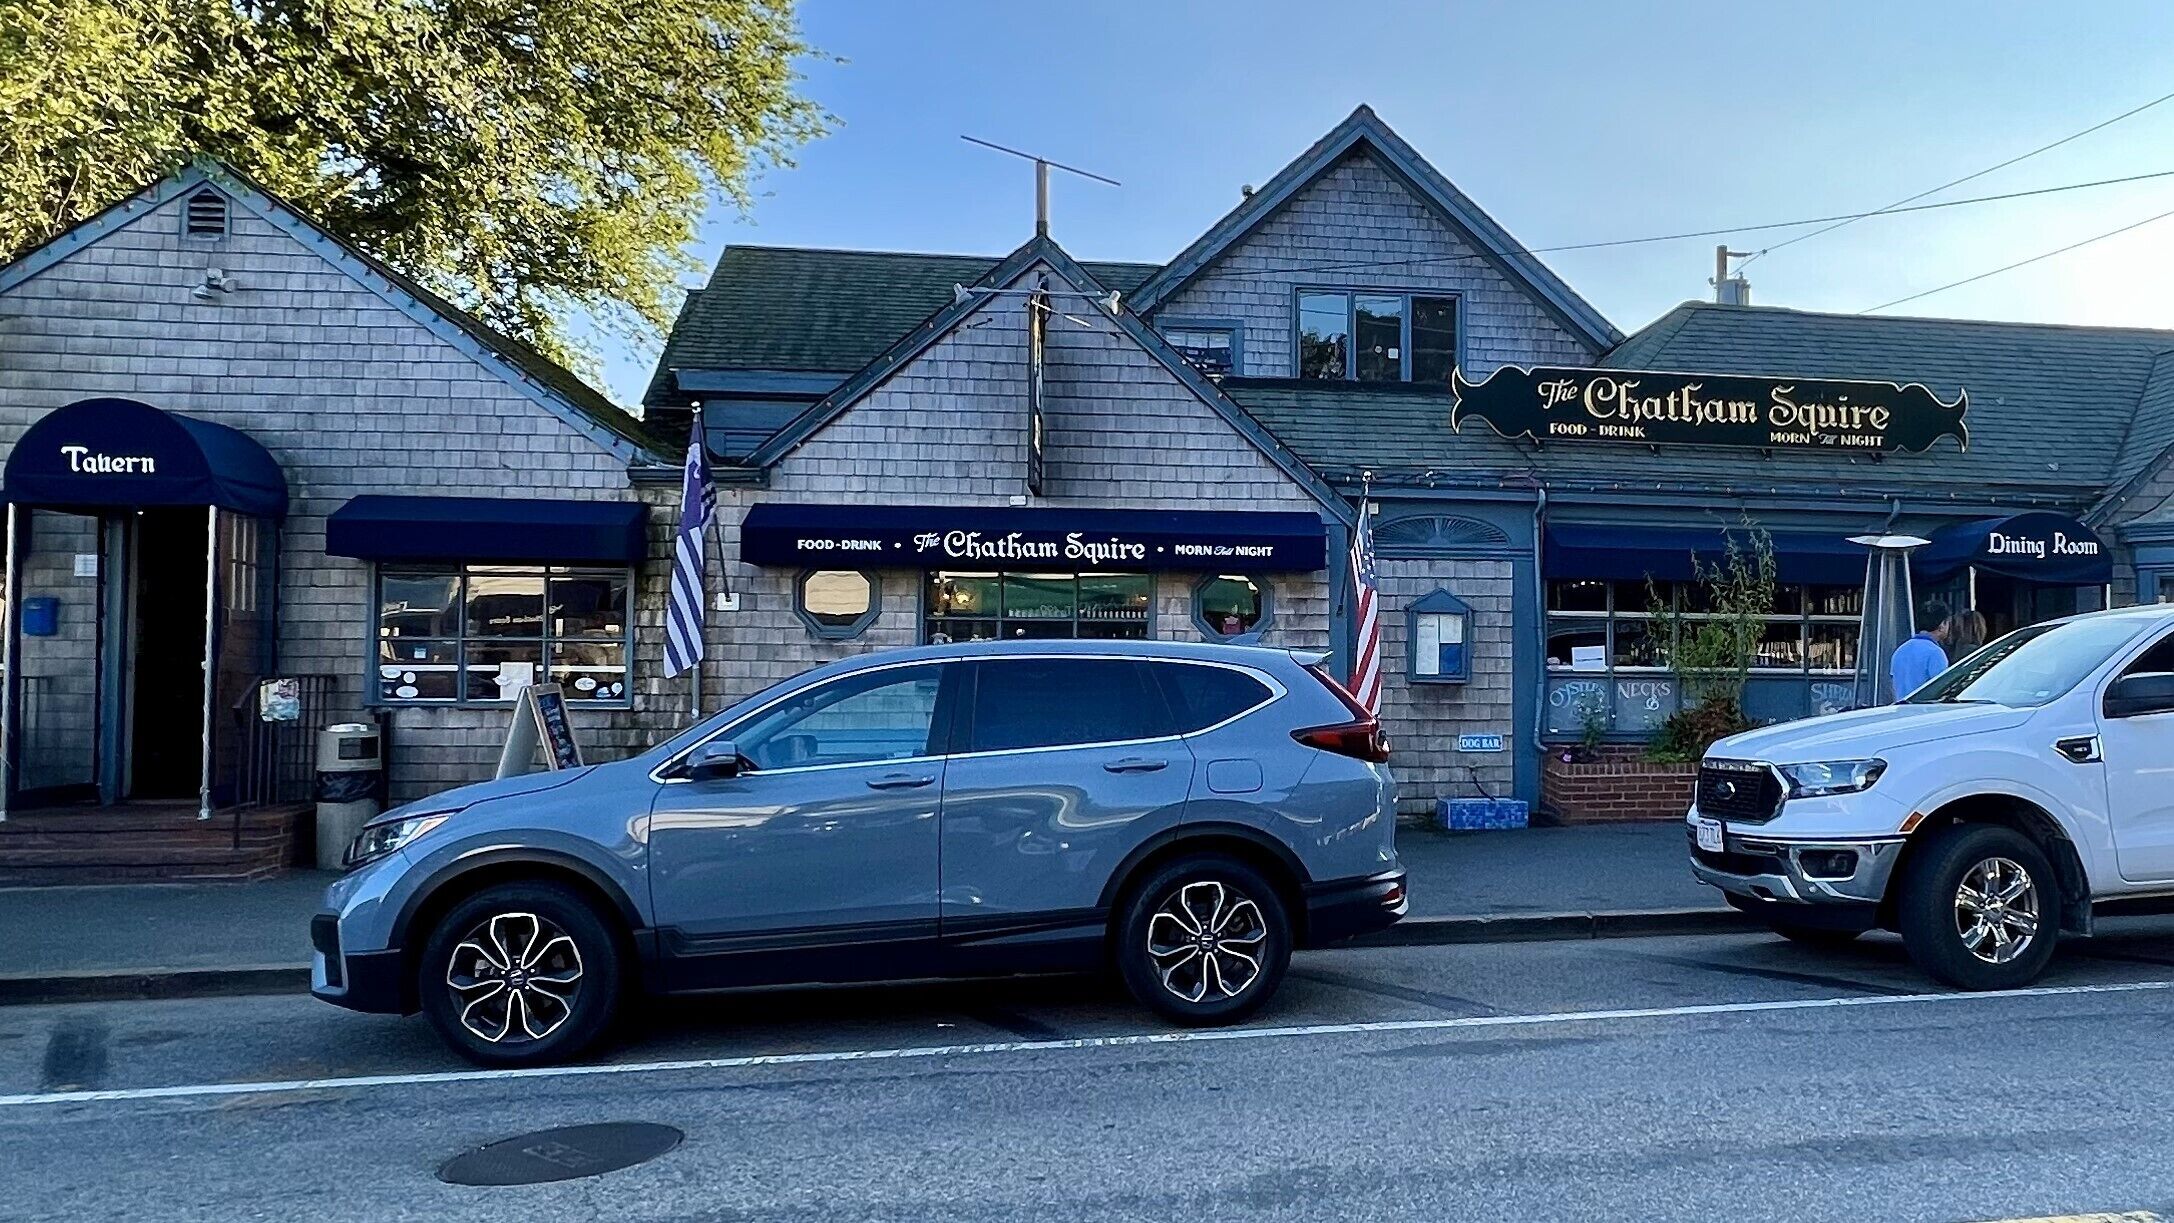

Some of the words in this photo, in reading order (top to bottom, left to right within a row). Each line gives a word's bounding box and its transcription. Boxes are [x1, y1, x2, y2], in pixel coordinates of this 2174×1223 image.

[1538, 379, 1578, 410] The
[1584, 377, 1758, 426] Chatham
[1768, 383, 1890, 434] Squire
[1549, 422, 1588, 436] FOOD
[1599, 424, 1646, 438] DRINK
[1770, 431, 1811, 444] MORN
[1840, 434, 1885, 447] NIGHT
[61, 445, 155, 474] Tavern
[913, 533, 941, 553] The
[943, 530, 1059, 560] Chatham
[1064, 532, 1146, 565] Squire
[1174, 544, 1213, 556] MORN
[1235, 545, 1274, 557] NIGHT
[1987, 532, 2045, 559] Dining
[2051, 531, 2098, 555] Room
[1617, 681, 1671, 699] NECKS
[1461, 739, 1481, 749] DOG
[1482, 738, 1501, 749] BAR
